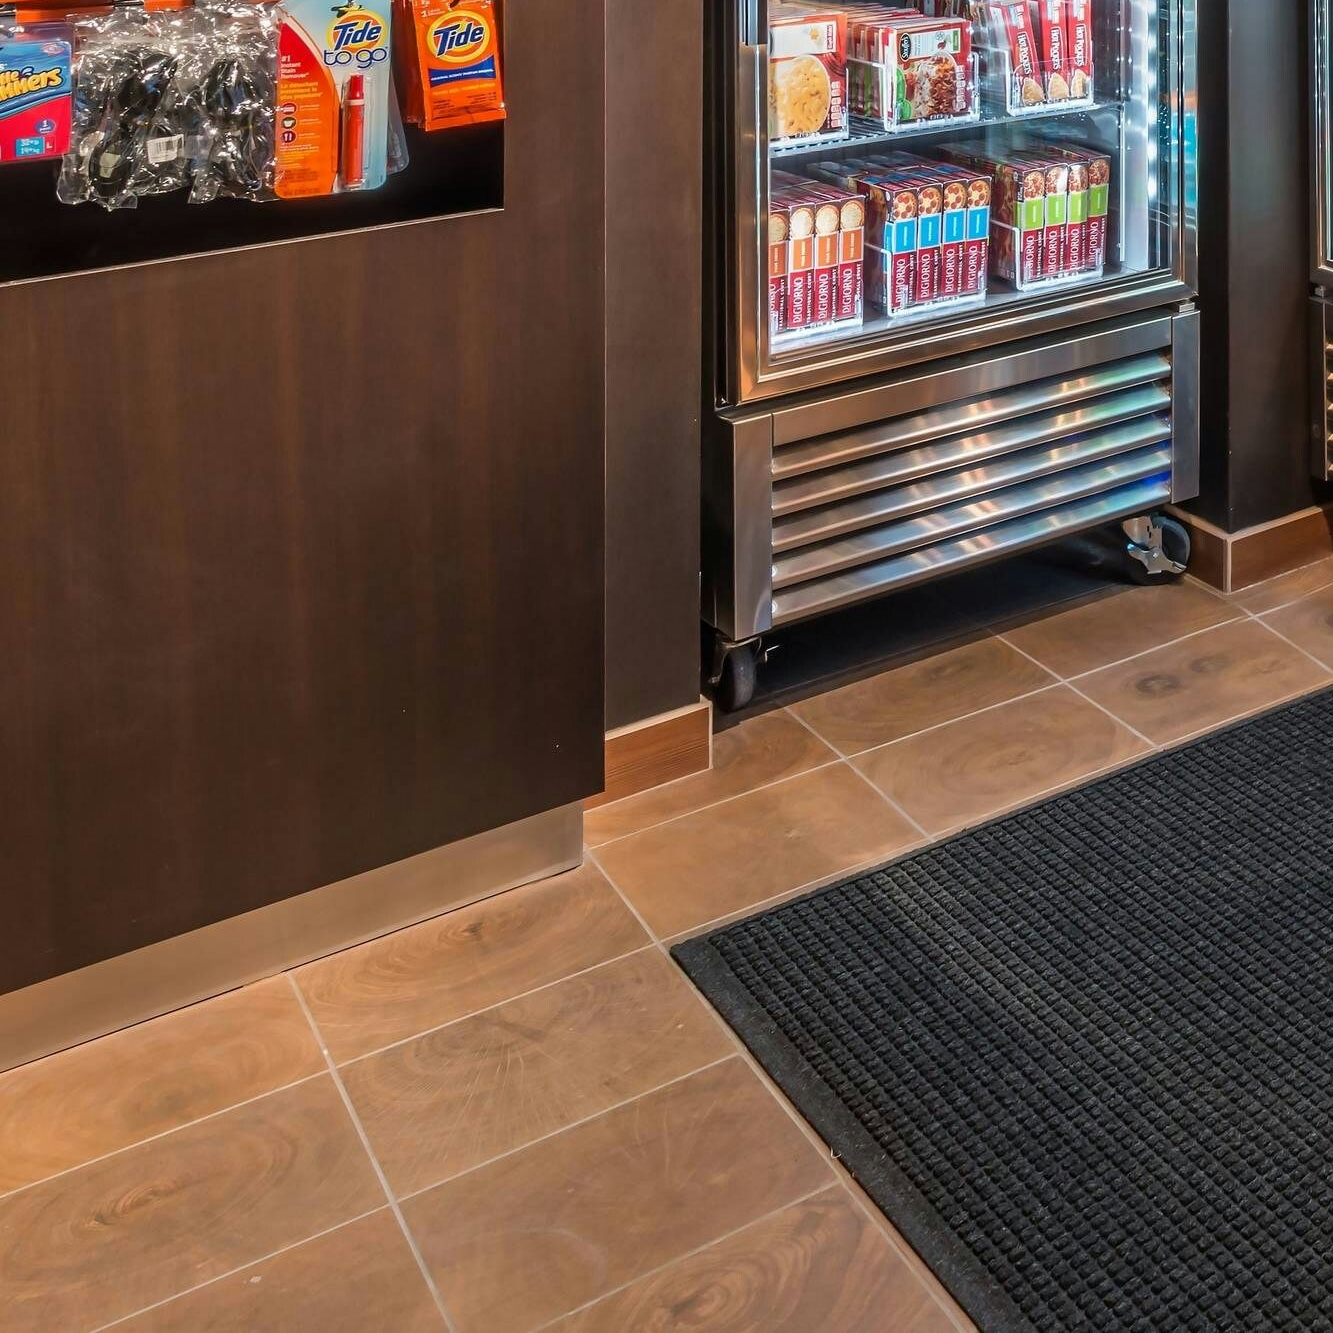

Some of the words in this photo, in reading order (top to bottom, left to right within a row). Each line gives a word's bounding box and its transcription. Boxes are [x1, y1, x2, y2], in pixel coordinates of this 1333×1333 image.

[324, 49, 352, 67] to
[356, 47, 387, 69] go
[334, 21, 383, 51] Tide
[434, 23, 485, 57] Tide
[1088, 222, 1098, 263] DIGIORNO
[921, 254, 931, 298] DIGIORNO
[945, 247, 956, 294] DIGIORNO
[967, 245, 979, 290] DIGIORNO
[793, 277, 803, 324] DIGIORNO
[819, 273, 828, 321] DIGIORNO
[842, 268, 853, 314] DIGIORNO
